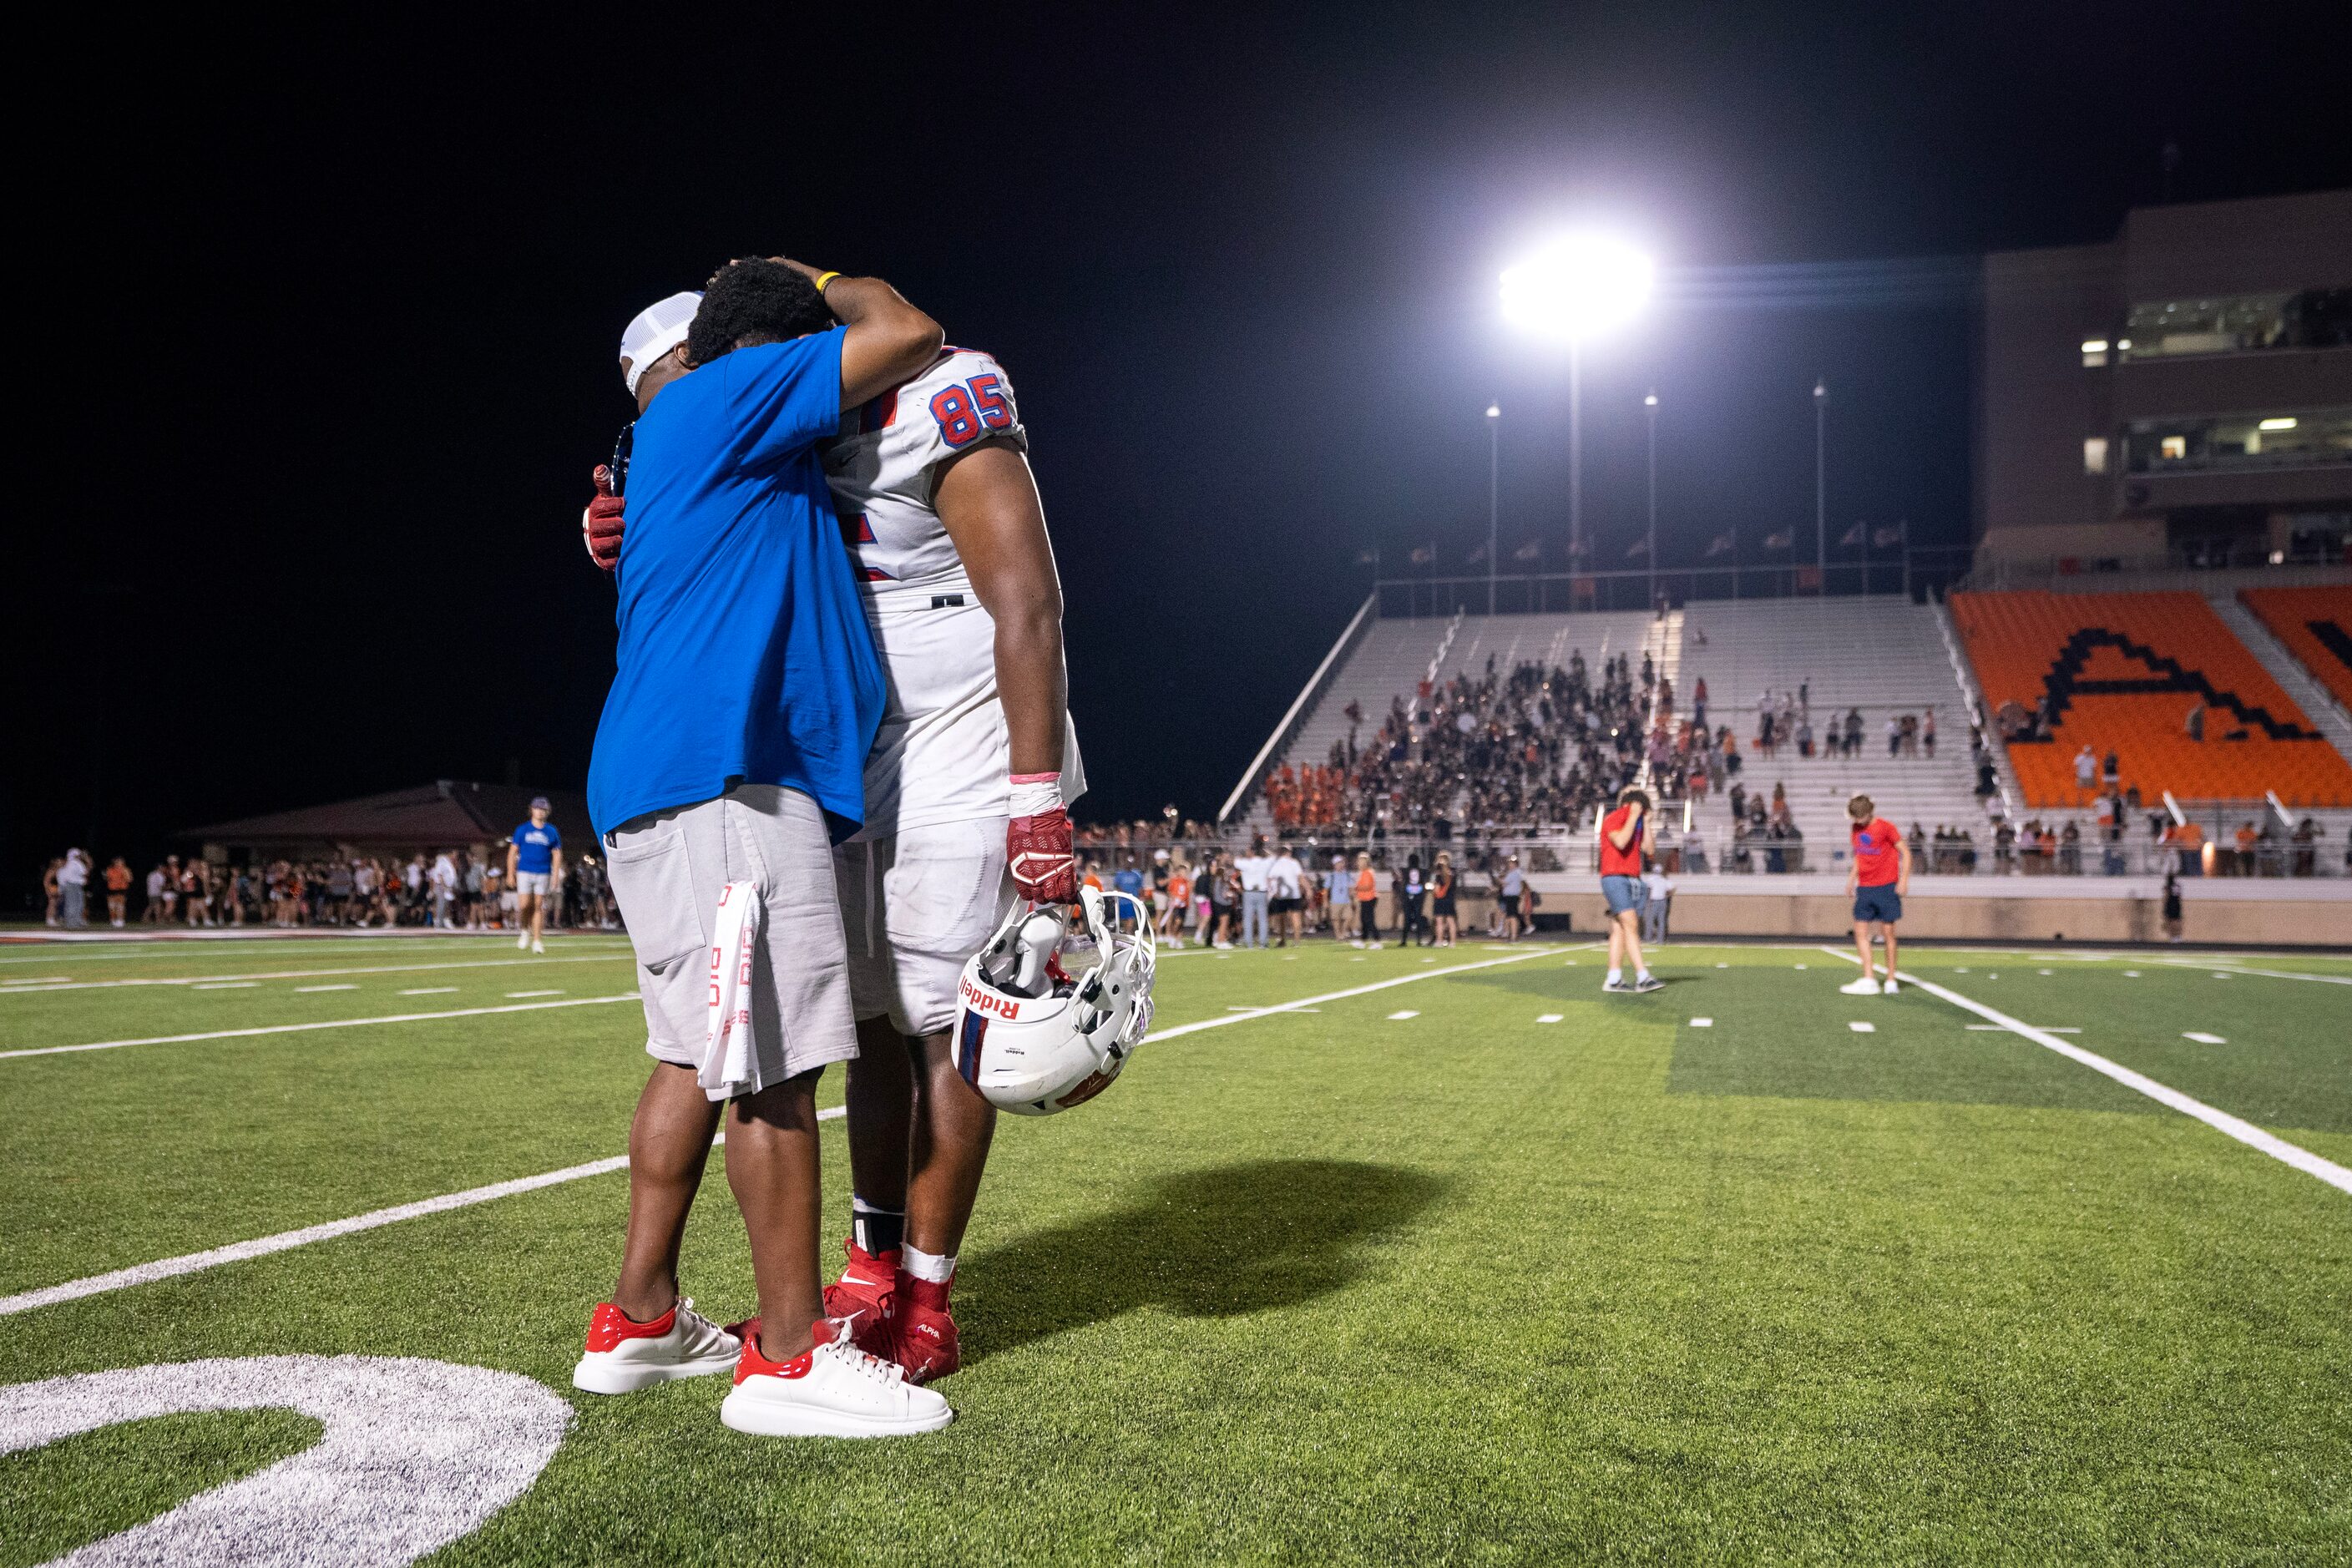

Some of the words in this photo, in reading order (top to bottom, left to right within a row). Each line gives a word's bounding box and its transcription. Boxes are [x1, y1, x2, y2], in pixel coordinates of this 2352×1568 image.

[928, 373, 1013, 449] 85
[959, 975, 1019, 1019] Riddell
[918, 1323, 939, 1339] ALPHA
